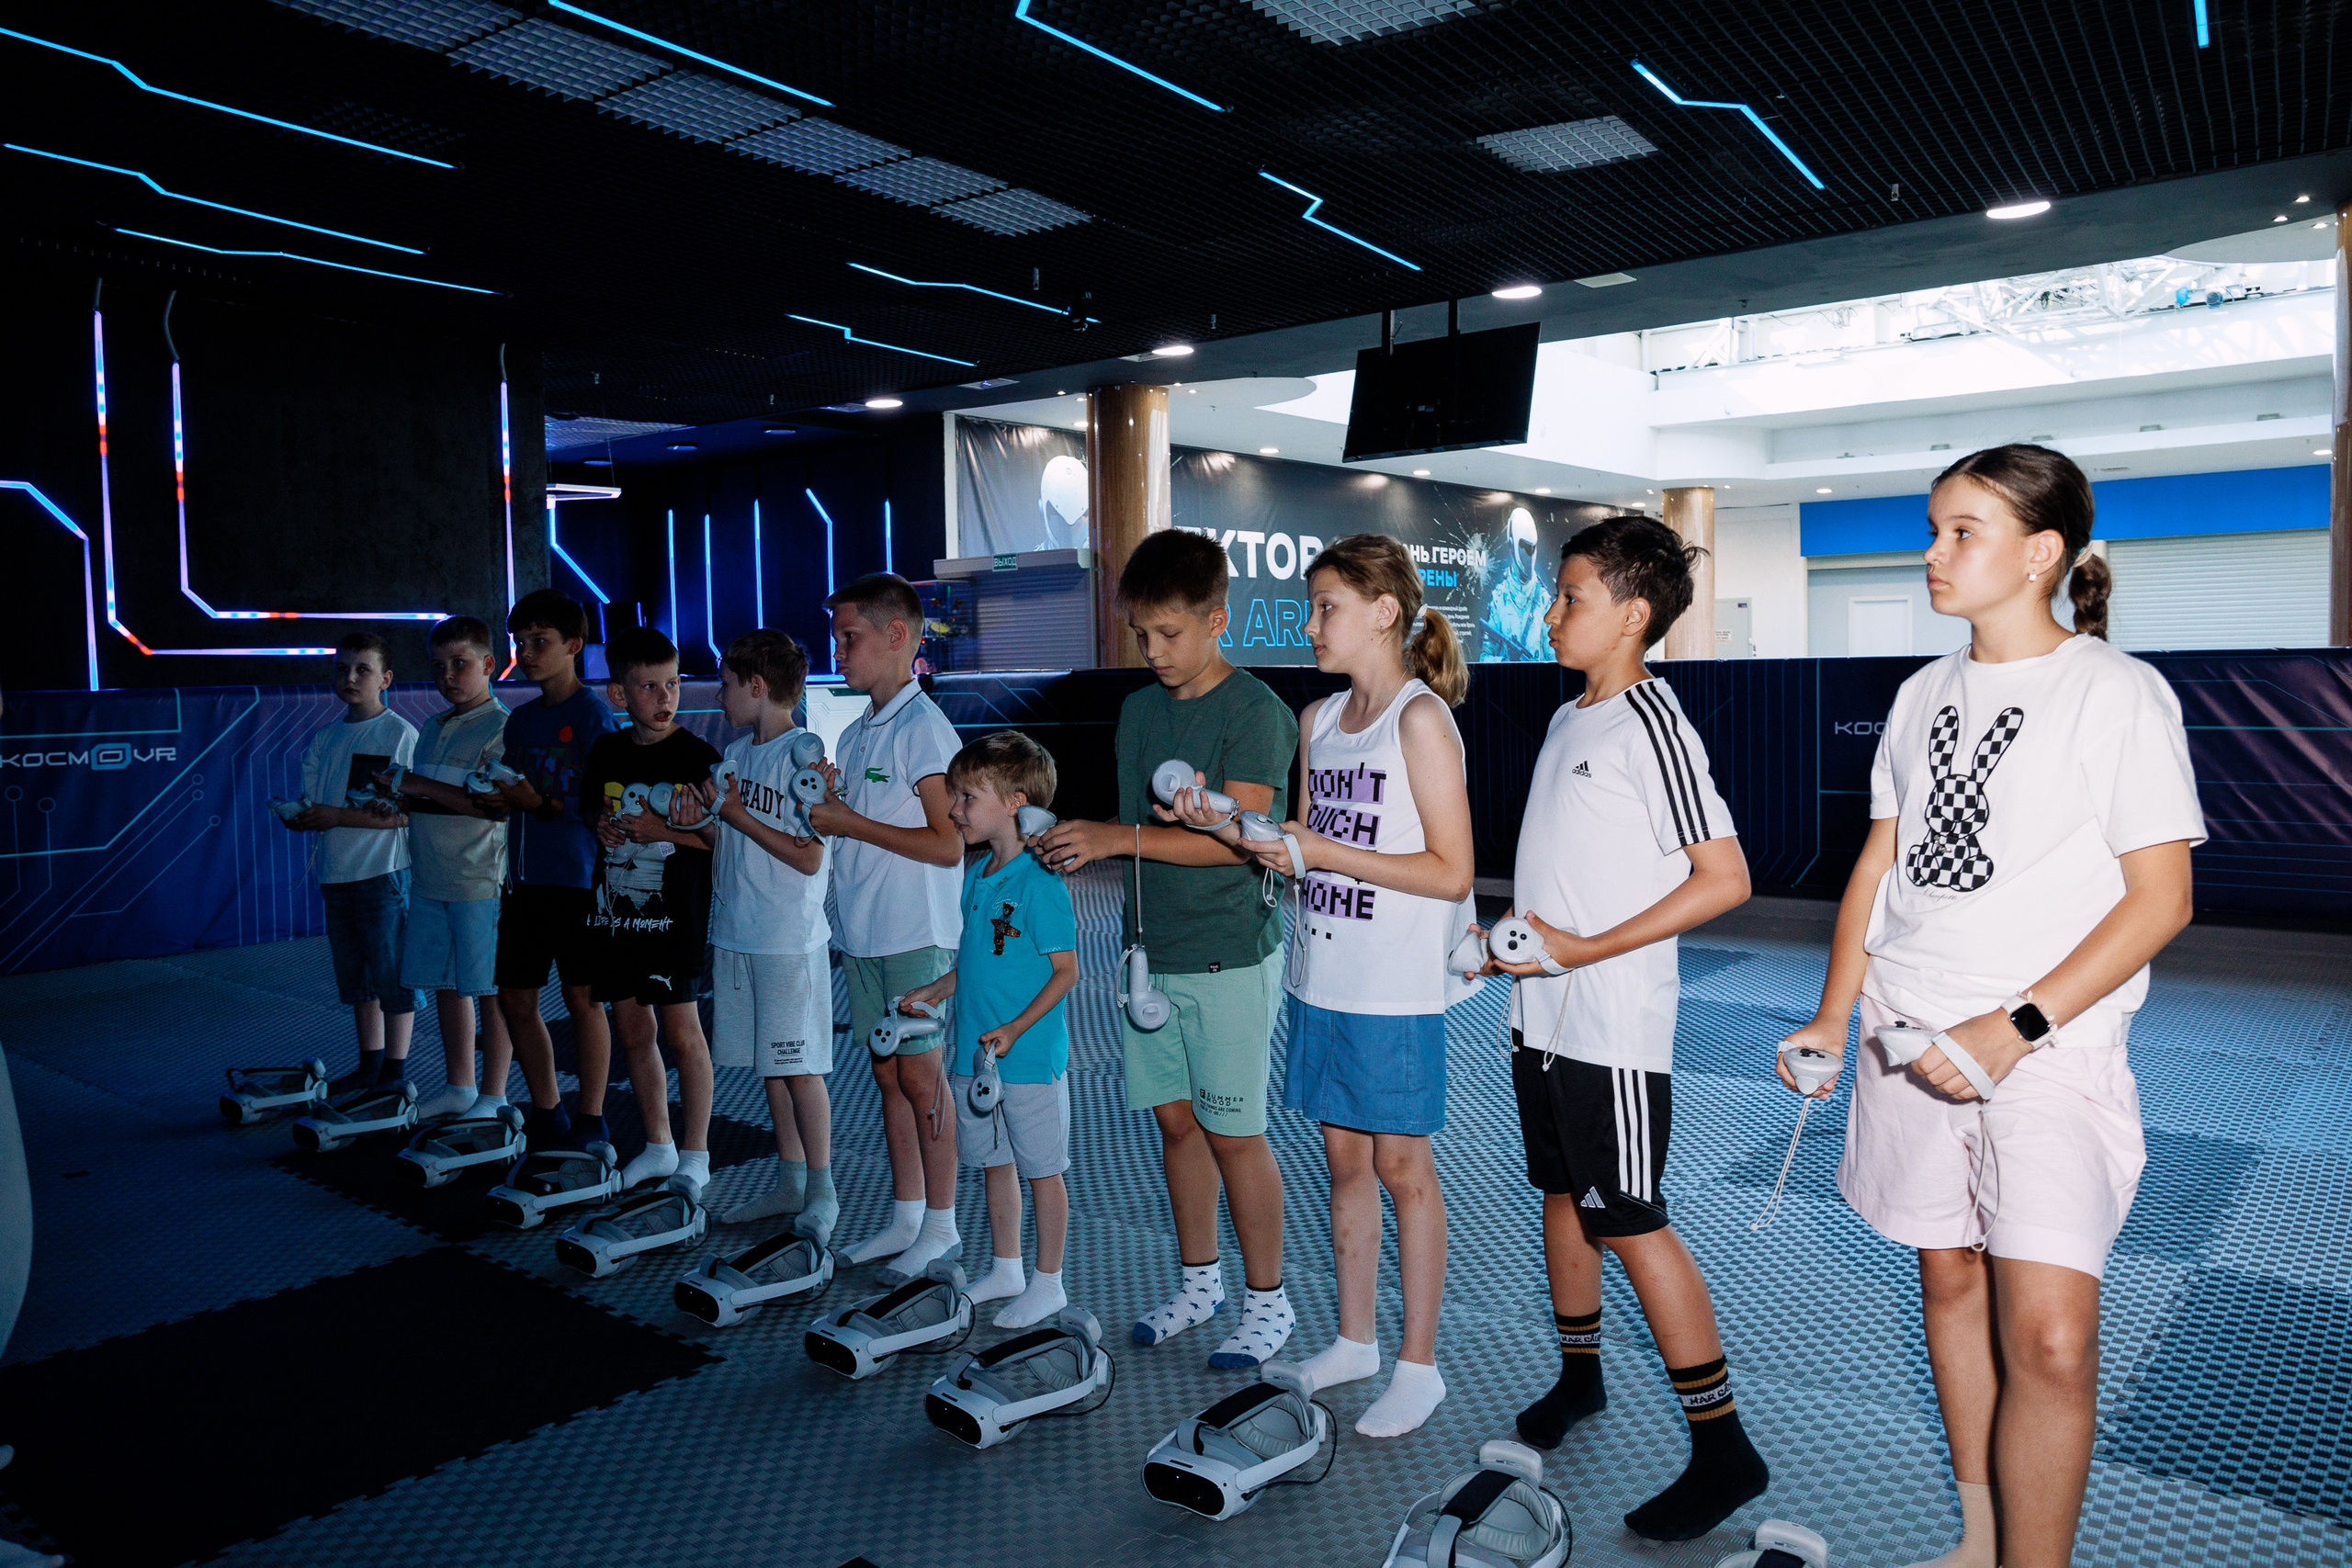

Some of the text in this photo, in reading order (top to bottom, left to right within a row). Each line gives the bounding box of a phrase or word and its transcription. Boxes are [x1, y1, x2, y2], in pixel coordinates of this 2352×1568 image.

[994, 557, 1017, 567] ВЫХОД
[1432, 547, 1487, 567] ГЕРОЕМ
[1419, 569, 1457, 588] РЕНЫ
[1243, 599, 1312, 647] AR
[1835, 721, 1887, 735] КОС
[1572, 768, 1592, 778] adidas
[1308, 804, 1379, 845] OUCH
[1303, 881, 1376, 920] HONE
[624, 918, 630, 931] A
[632, 916, 674, 932] MOMENT
[1206, 1091, 1244, 1102] SUMMER
[1206, 1097, 1231, 1107] MOOD
